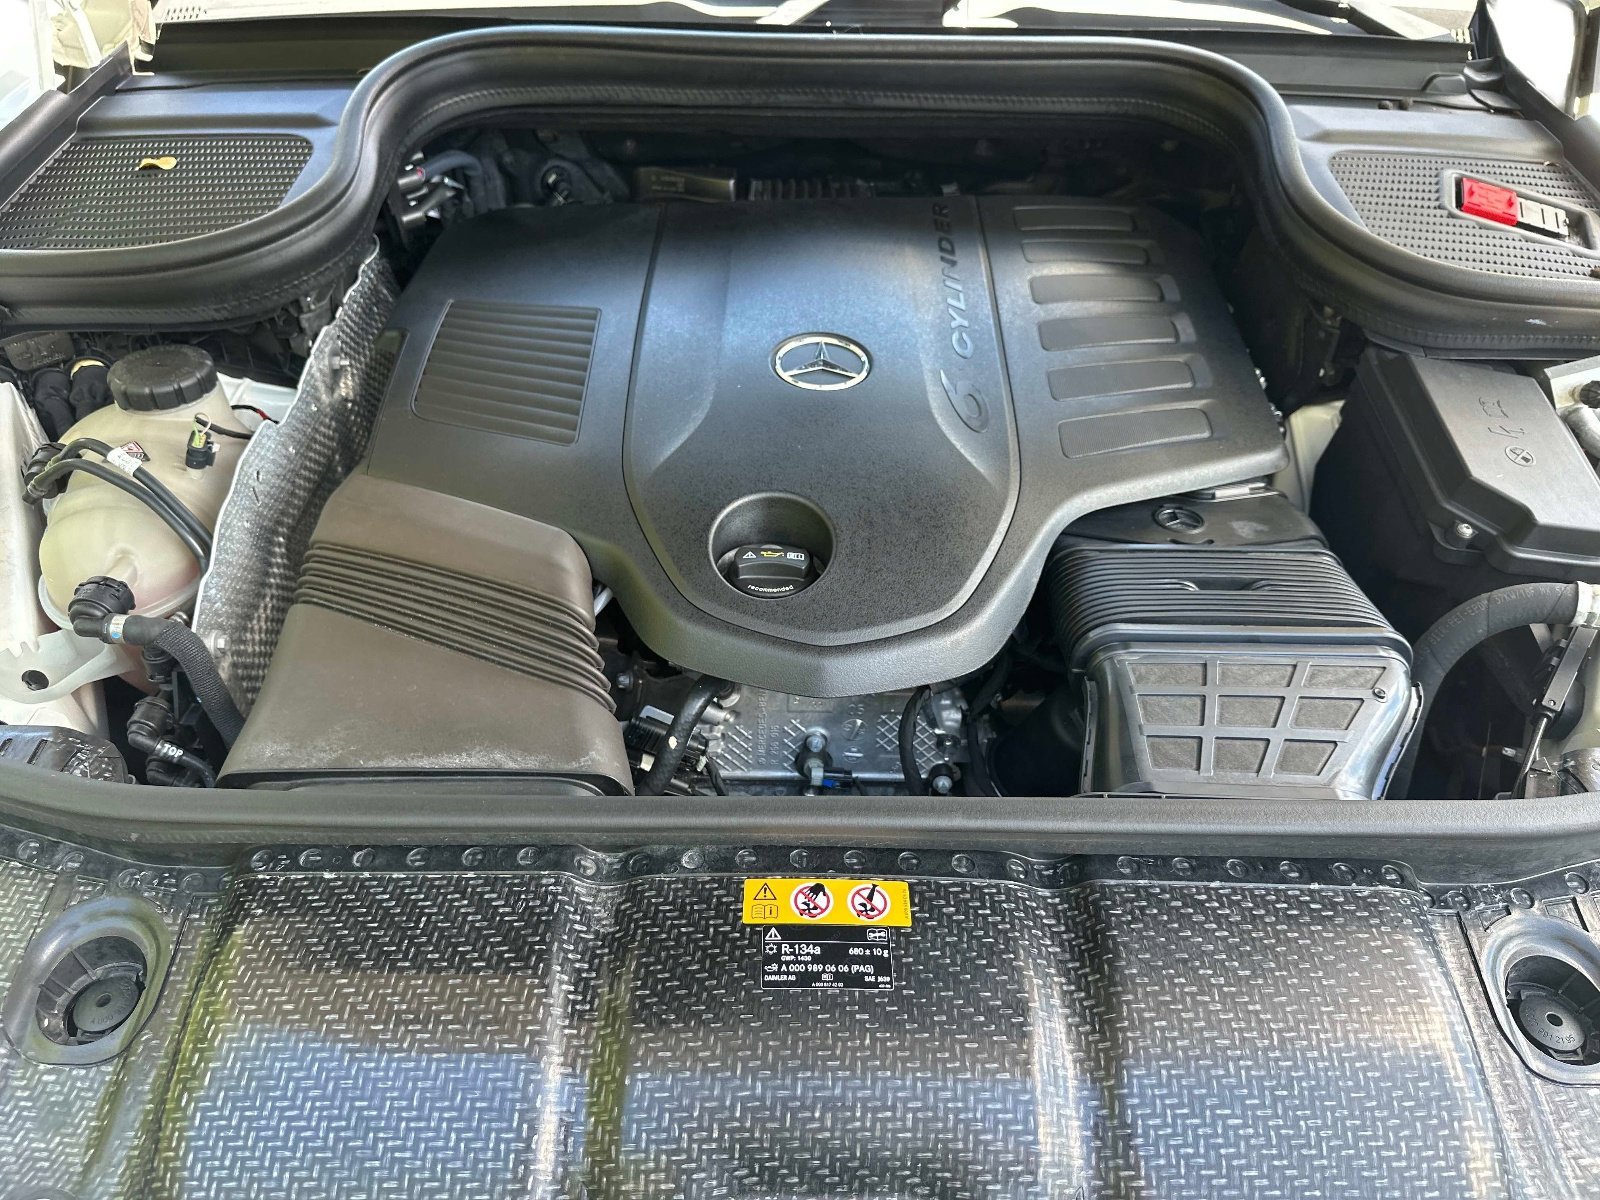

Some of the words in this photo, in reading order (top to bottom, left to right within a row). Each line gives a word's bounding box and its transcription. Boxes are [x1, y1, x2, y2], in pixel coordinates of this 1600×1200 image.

[932, 202, 974, 360] CYLINDER
[940, 368, 990, 434] 6
[747, 584, 794, 593] recommended
[163, 743, 184, 758] TOP
[781, 943, 821, 955] R-134a
[848, 947, 864, 956] 680
[873, 947, 883, 956] 10
[883, 949, 889, 958] g
[781, 963, 788, 972] A
[788, 963, 806, 972] 000
[807, 963, 824, 973] 989
[825, 964, 836, 973] 06
[838, 964, 849, 973] 06
[851, 964, 874, 975] (PAG)
